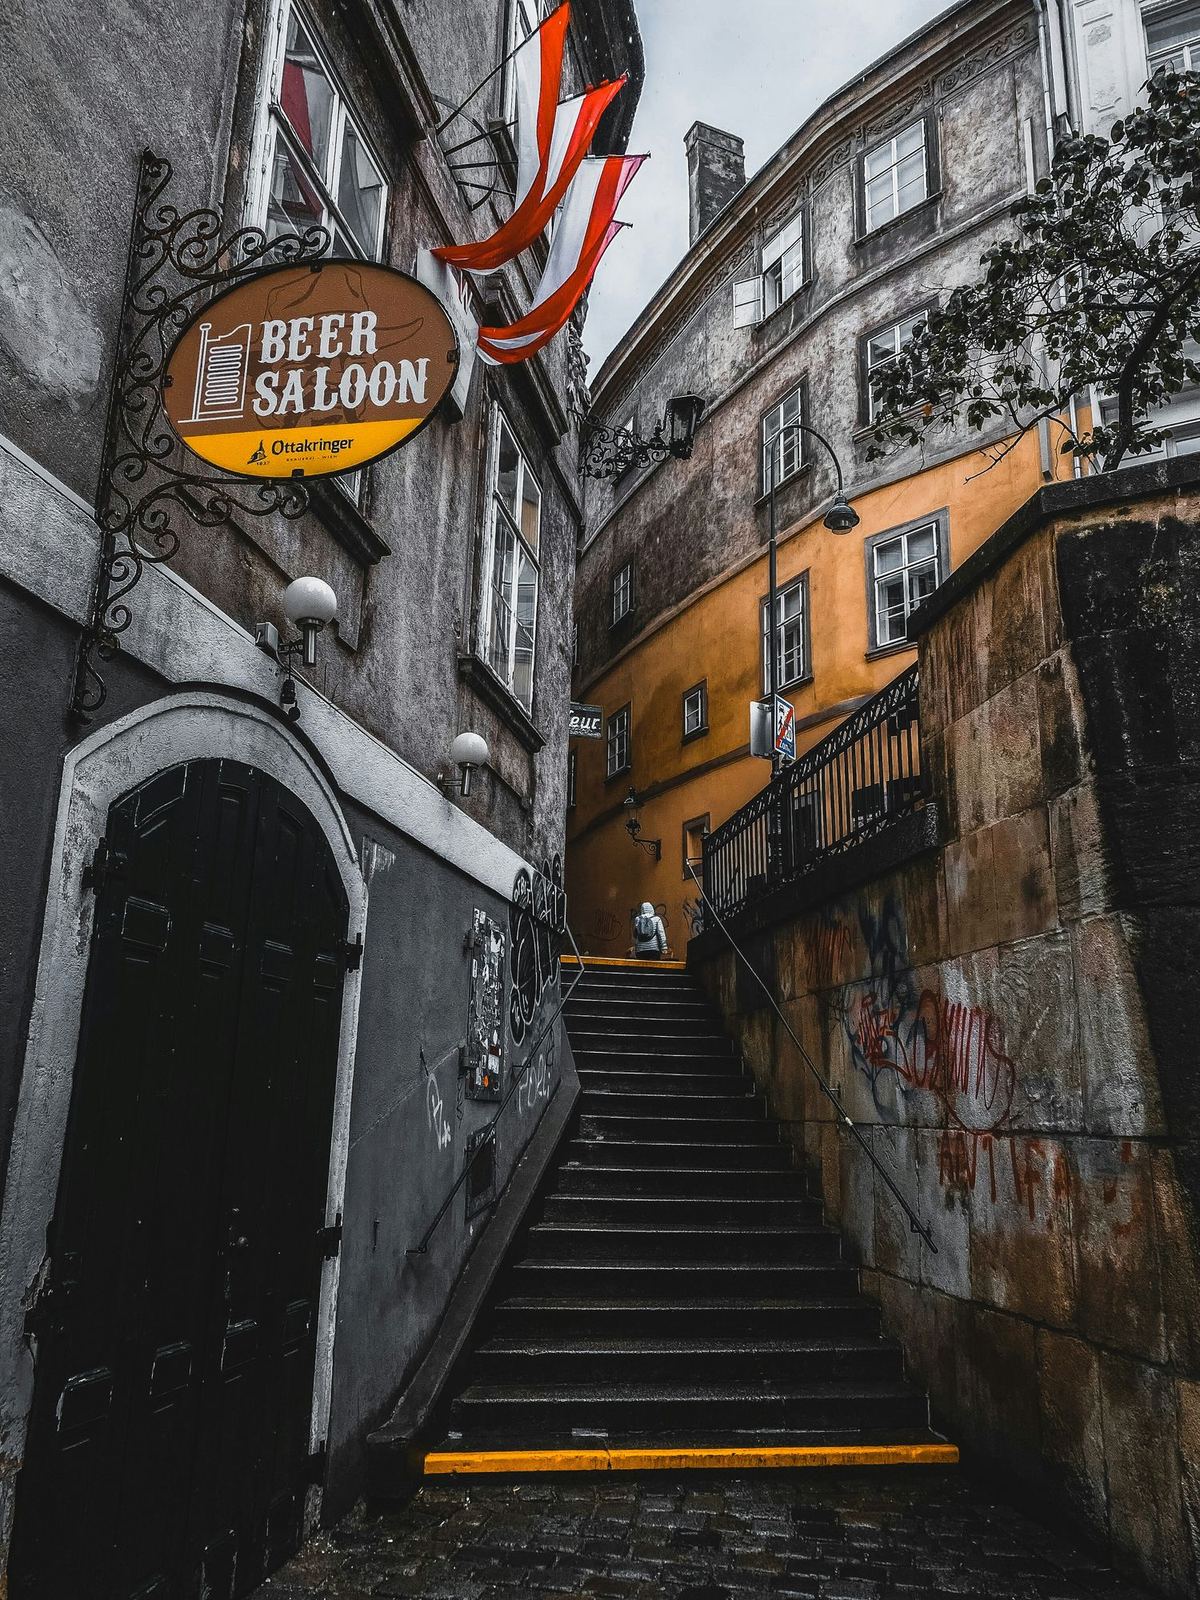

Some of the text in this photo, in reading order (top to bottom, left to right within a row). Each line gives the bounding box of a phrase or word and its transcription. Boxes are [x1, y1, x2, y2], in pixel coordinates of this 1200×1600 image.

[258, 310, 378, 364] BEER
[252, 357, 431, 417] SALOON
[271, 438, 354, 456] Ottakringer
[569, 710, 601, 730] eur
